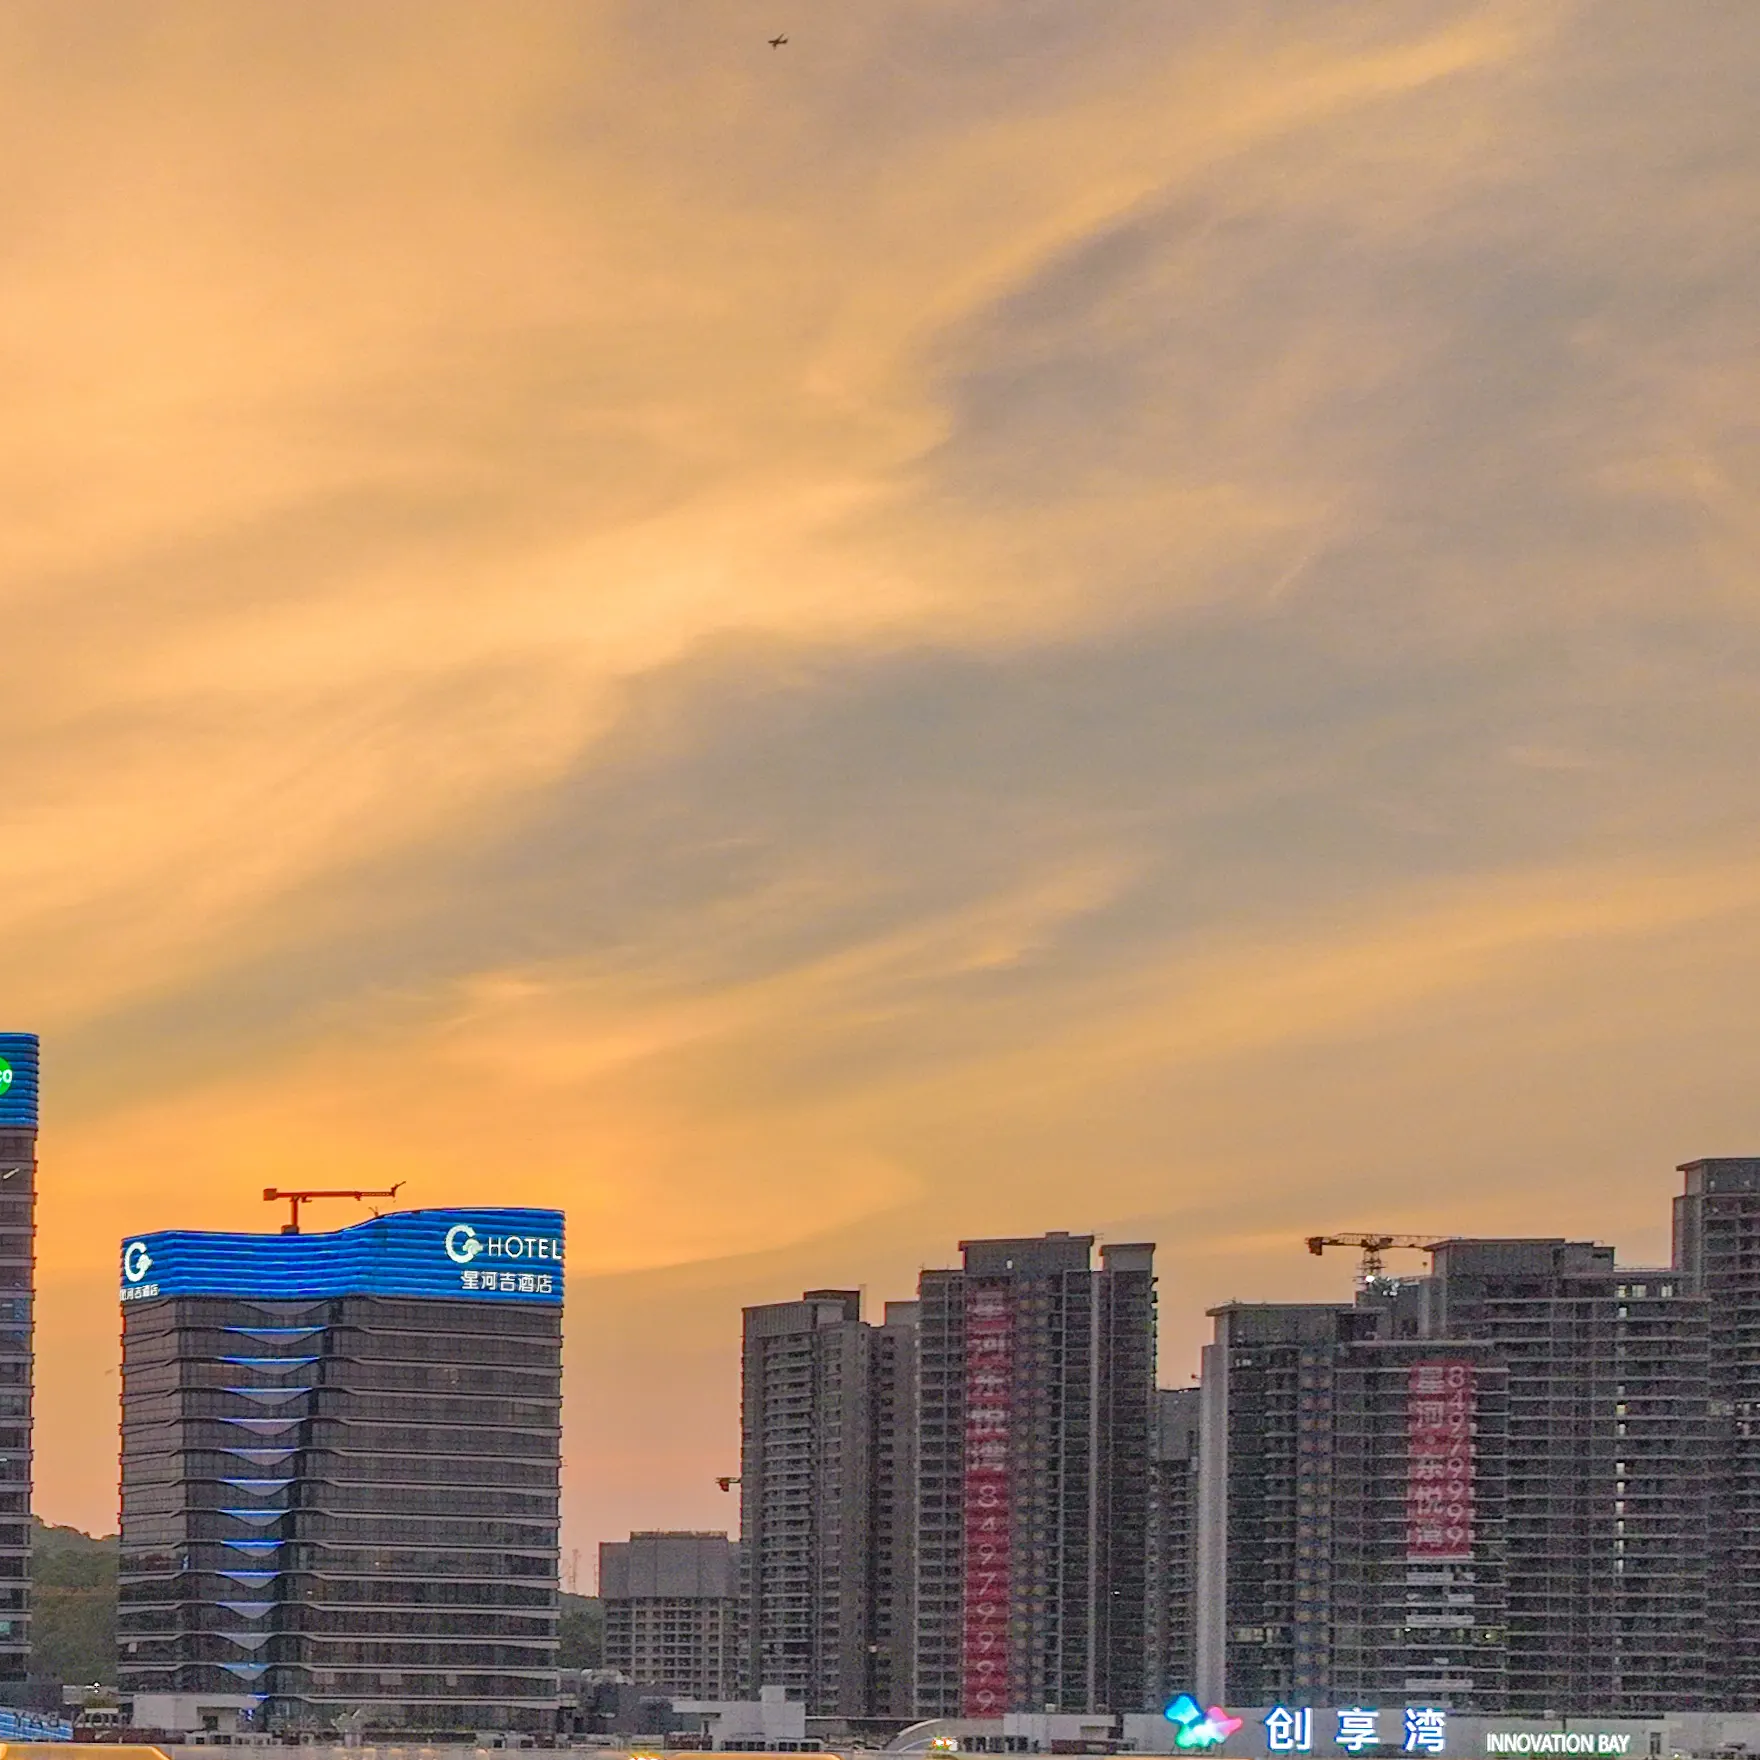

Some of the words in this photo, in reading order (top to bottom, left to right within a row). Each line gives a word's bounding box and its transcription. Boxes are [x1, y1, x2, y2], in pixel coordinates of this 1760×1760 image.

[488, 1236, 562, 1260] HOTEL
[460, 1270, 553, 1294] 星河吉酒店
[1447, 1365, 1465, 1548] 84979999
[976, 1484, 998, 1712] 84979999
[1265, 1707, 1446, 1752] 创享湾
[1486, 1733, 1594, 1753] INNOVATION
[1597, 1734, 1631, 1754] BAY
